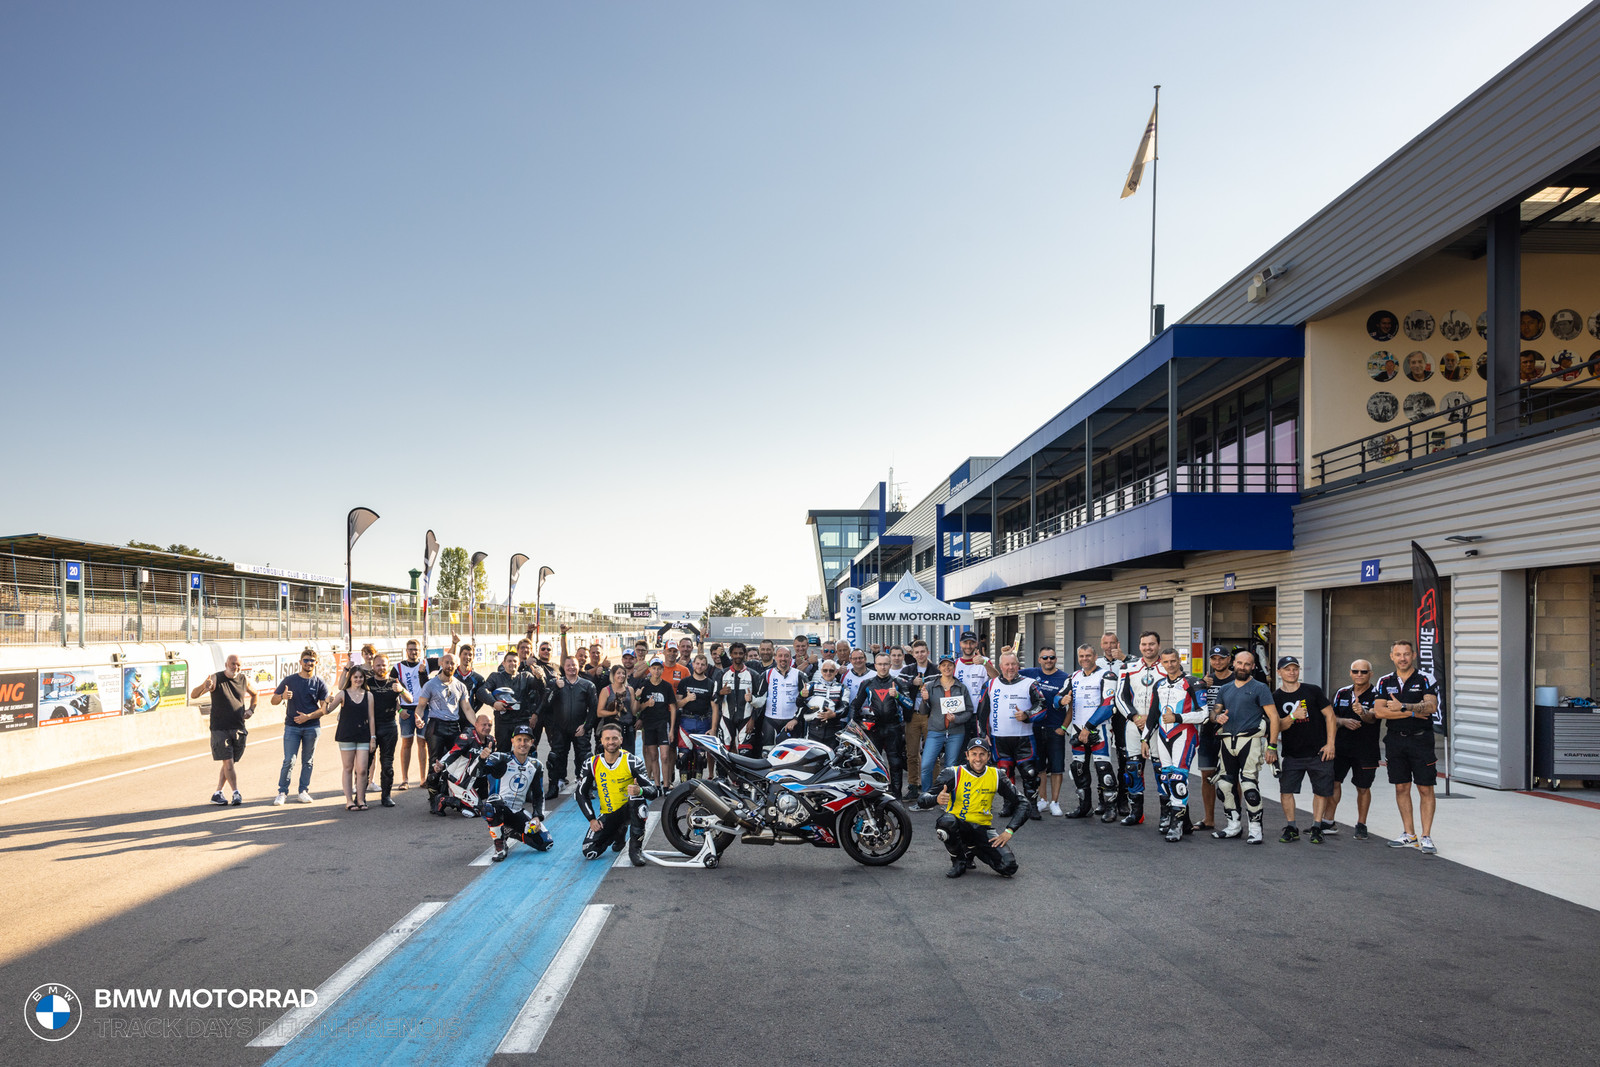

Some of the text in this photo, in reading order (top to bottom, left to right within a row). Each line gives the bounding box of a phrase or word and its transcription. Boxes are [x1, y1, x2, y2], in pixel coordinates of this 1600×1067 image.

[69, 566, 78, 576] 20
[1365, 564, 1374, 577] 21
[868, 613, 961, 621] BMW MOTORRAD
[946, 699, 959, 708] 232
[992, 688, 1001, 732] TRACKDAYS
